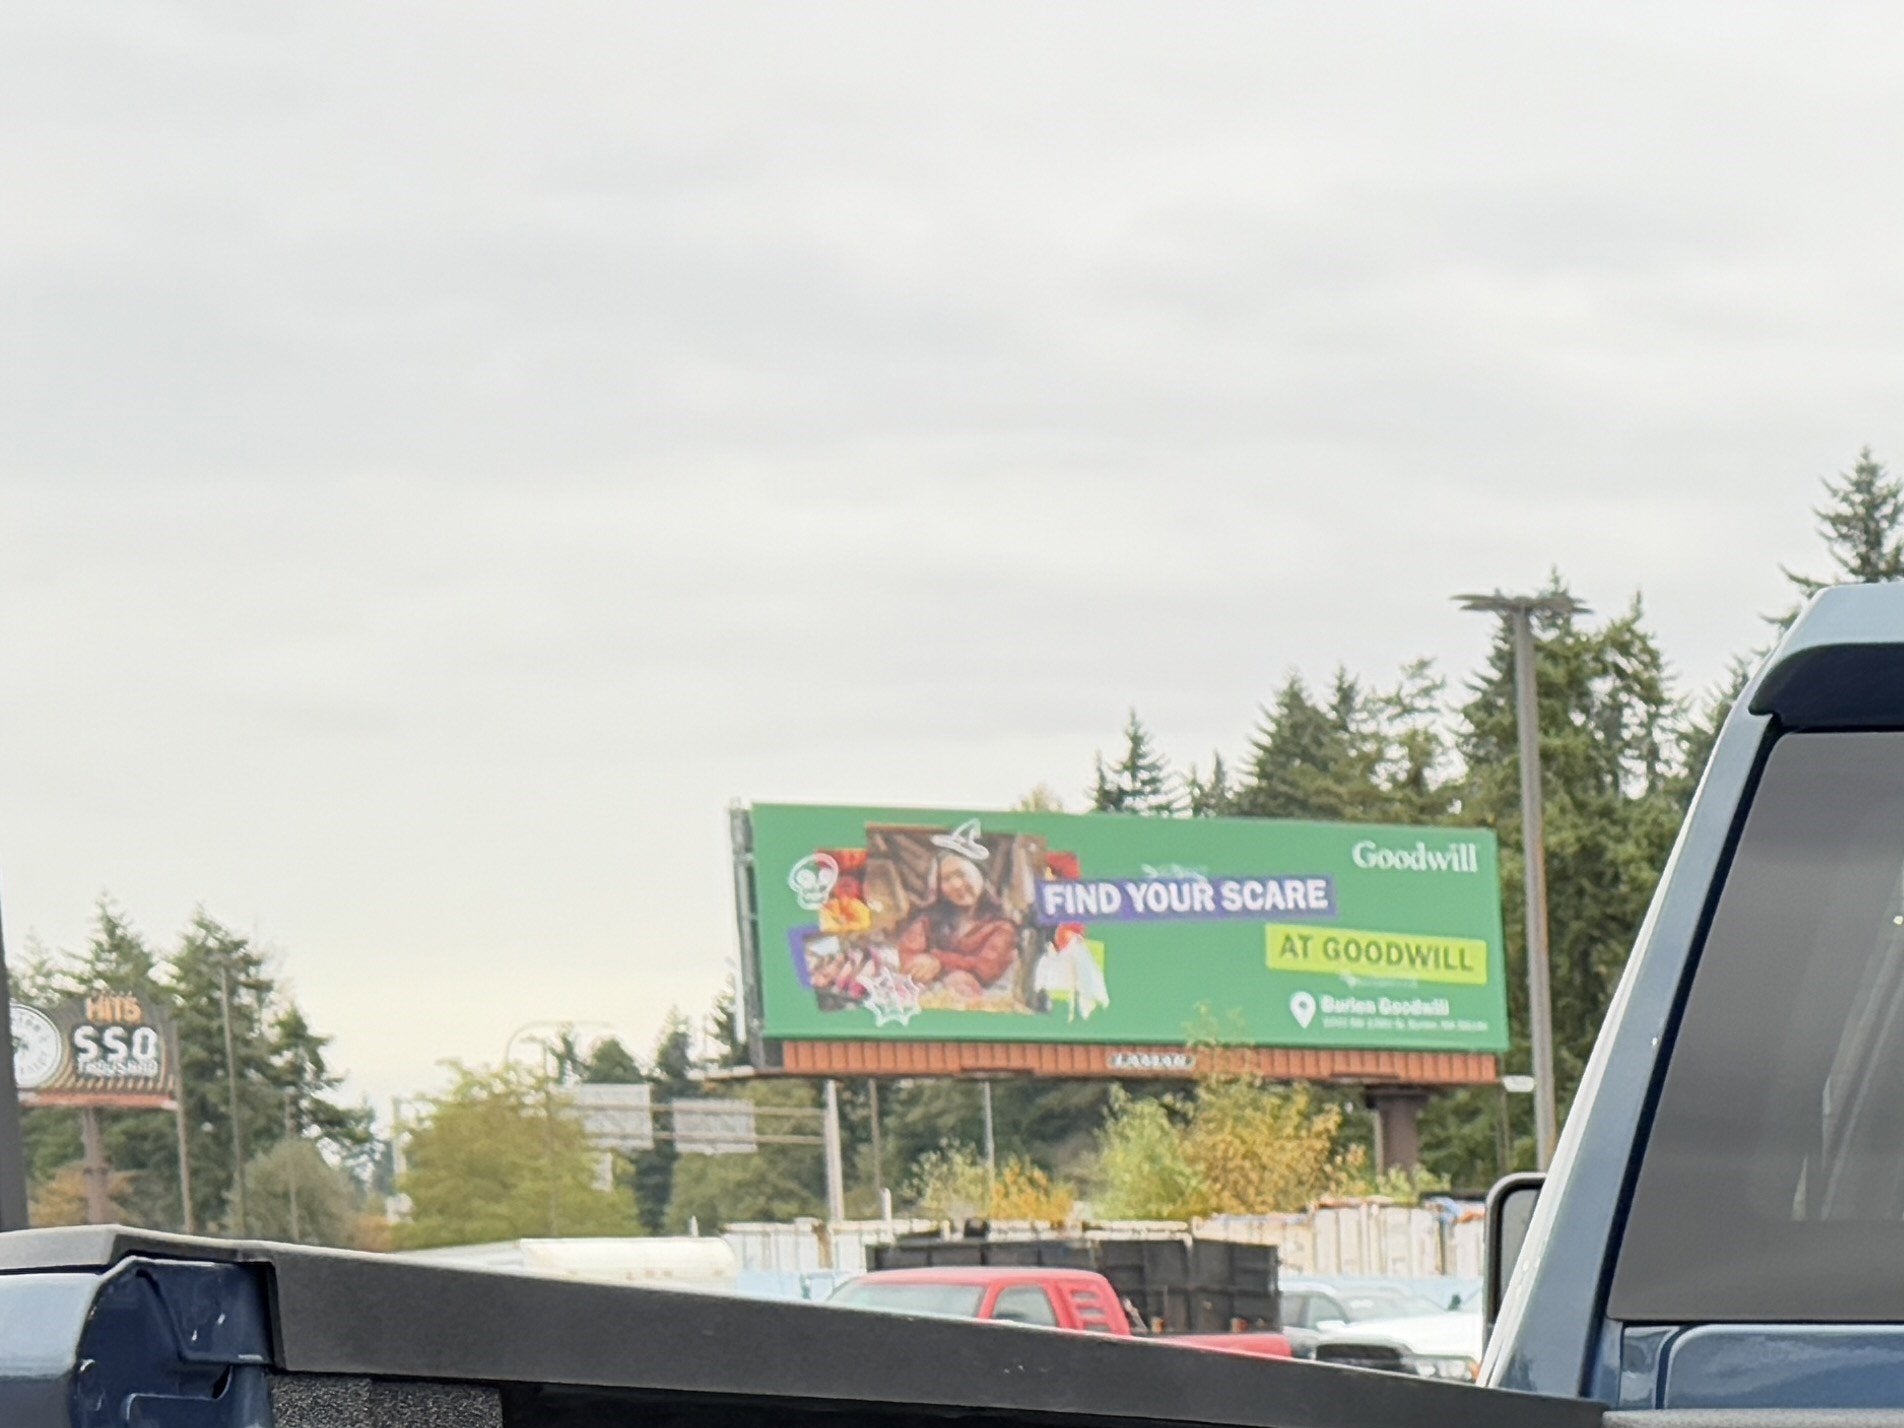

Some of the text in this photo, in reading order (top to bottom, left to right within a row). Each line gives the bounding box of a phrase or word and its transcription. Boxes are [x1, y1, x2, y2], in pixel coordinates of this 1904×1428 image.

[1352, 840, 1478, 873] Goodwill
[1043, 879, 1329, 916] FIND YOUR SCARE
[1280, 933, 1475, 972] AT GOODWILL
